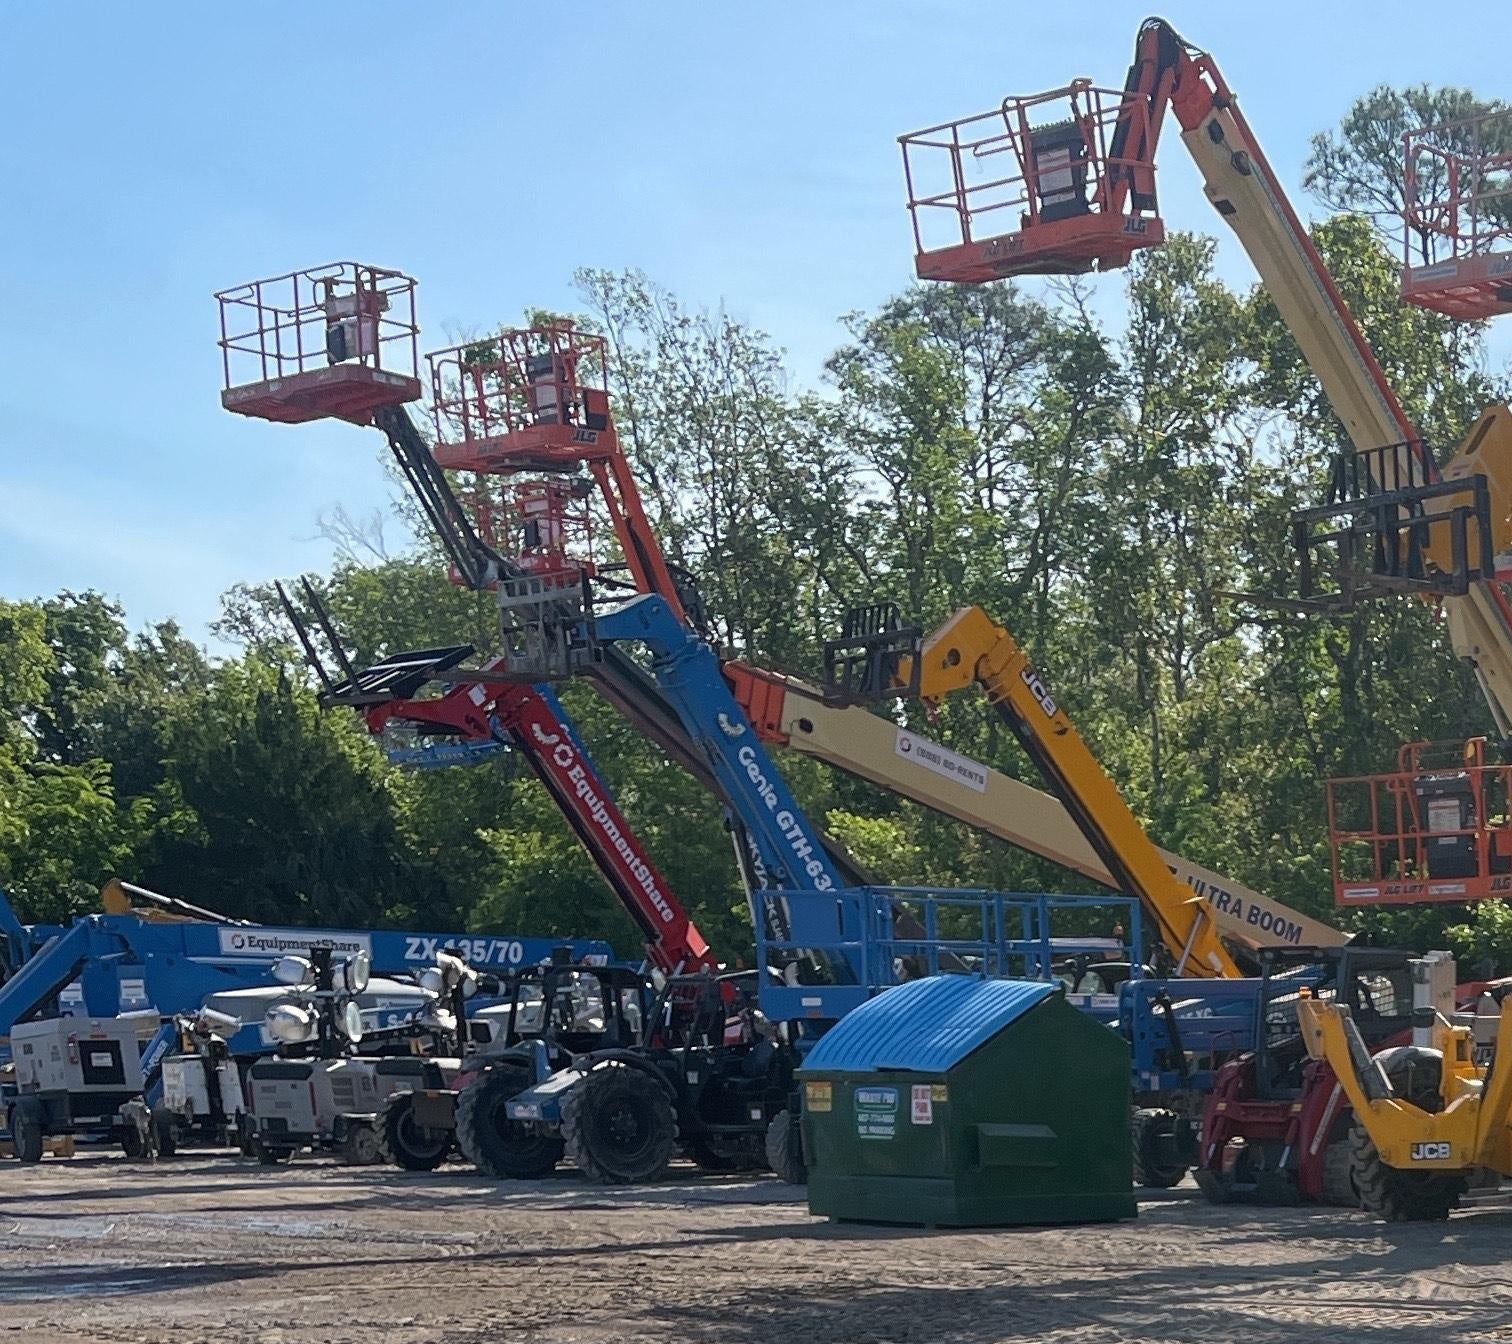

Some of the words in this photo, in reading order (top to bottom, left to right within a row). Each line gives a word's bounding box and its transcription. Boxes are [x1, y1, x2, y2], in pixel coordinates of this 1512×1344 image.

[573, 429, 597, 443] JLG
[1020, 668, 1058, 718] JCB
[738, 746, 778, 812] Genie
[567, 764, 675, 923] EquipmentShare
[1246, 904, 1303, 945] BOOM
[1410, 1141, 1452, 1161] JCB
